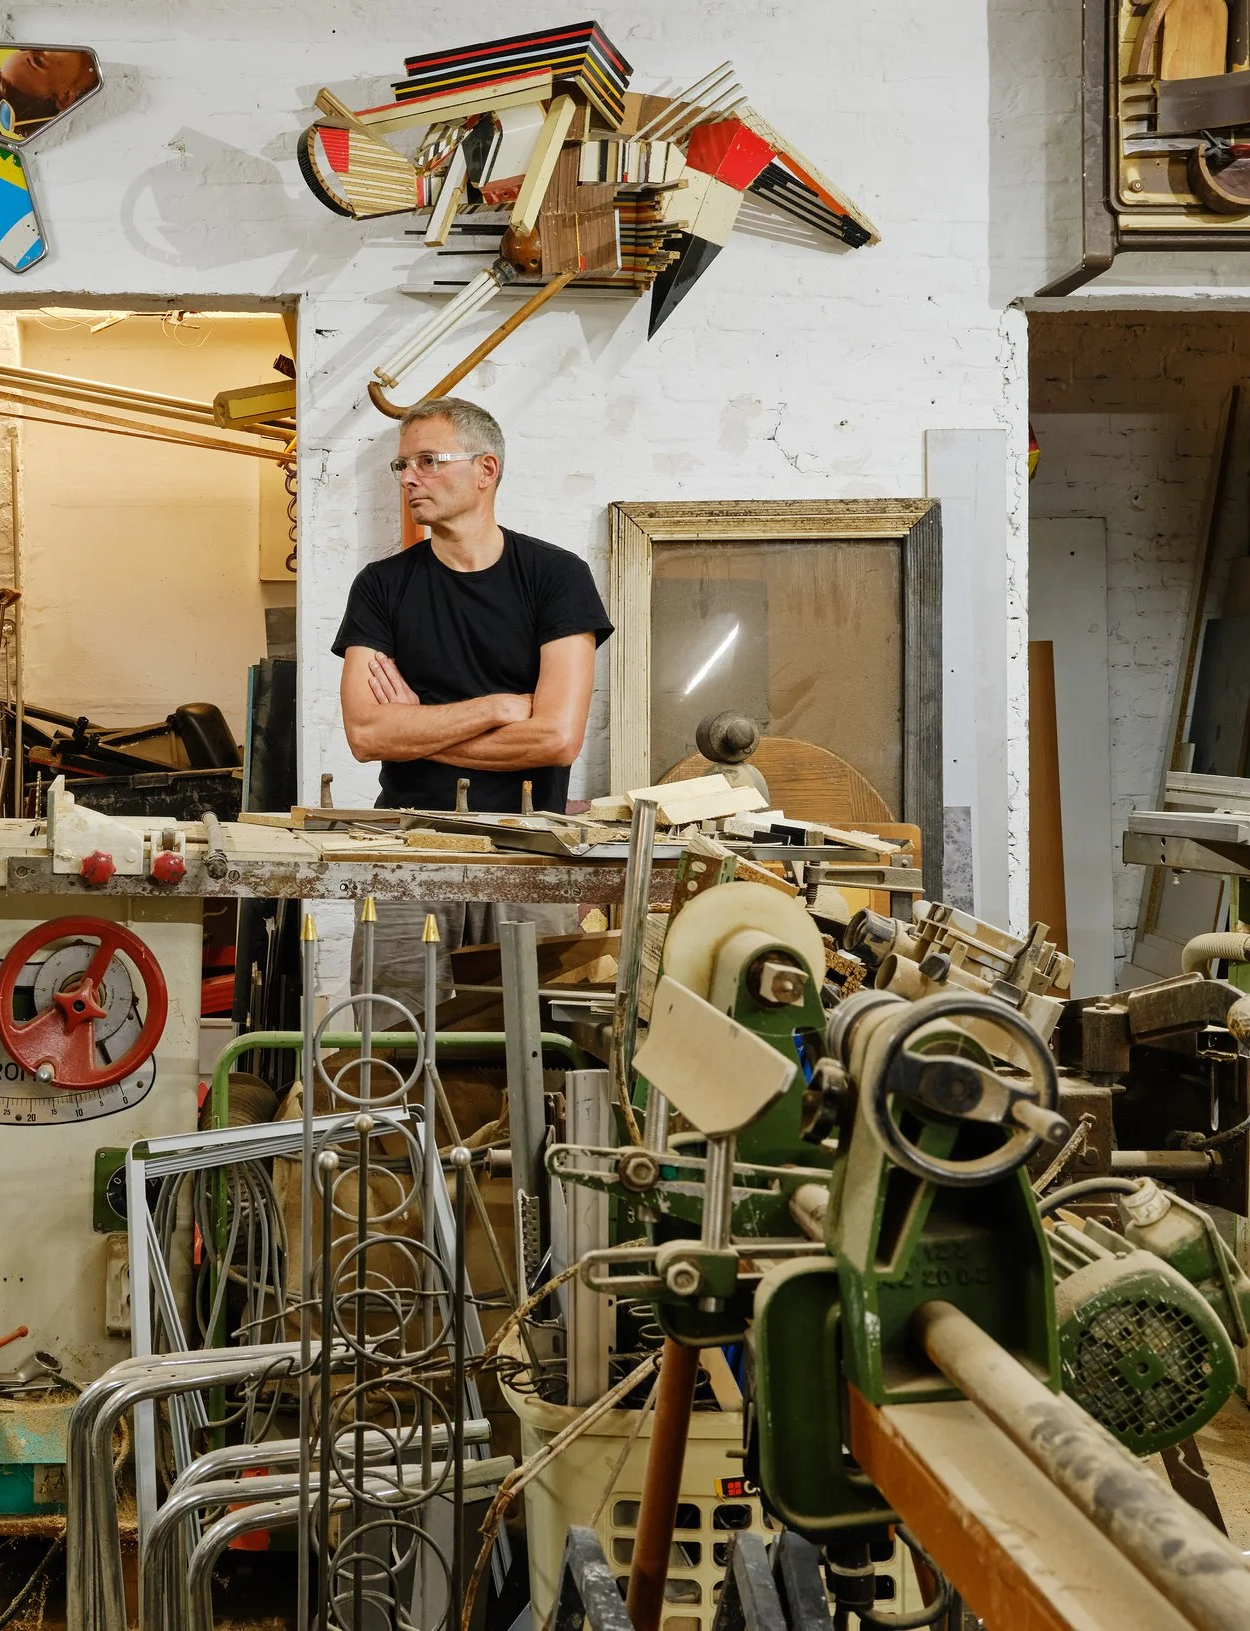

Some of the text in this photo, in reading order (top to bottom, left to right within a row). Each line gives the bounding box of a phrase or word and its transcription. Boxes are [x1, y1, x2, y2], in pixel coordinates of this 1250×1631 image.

[3, 1108, 11, 1116] 25
[27, 1113, 36, 1122] 20
[75, 1108, 84, 1117] 10
[122, 1096, 128, 1105] 0
[114, 1177, 122, 1185] 0
